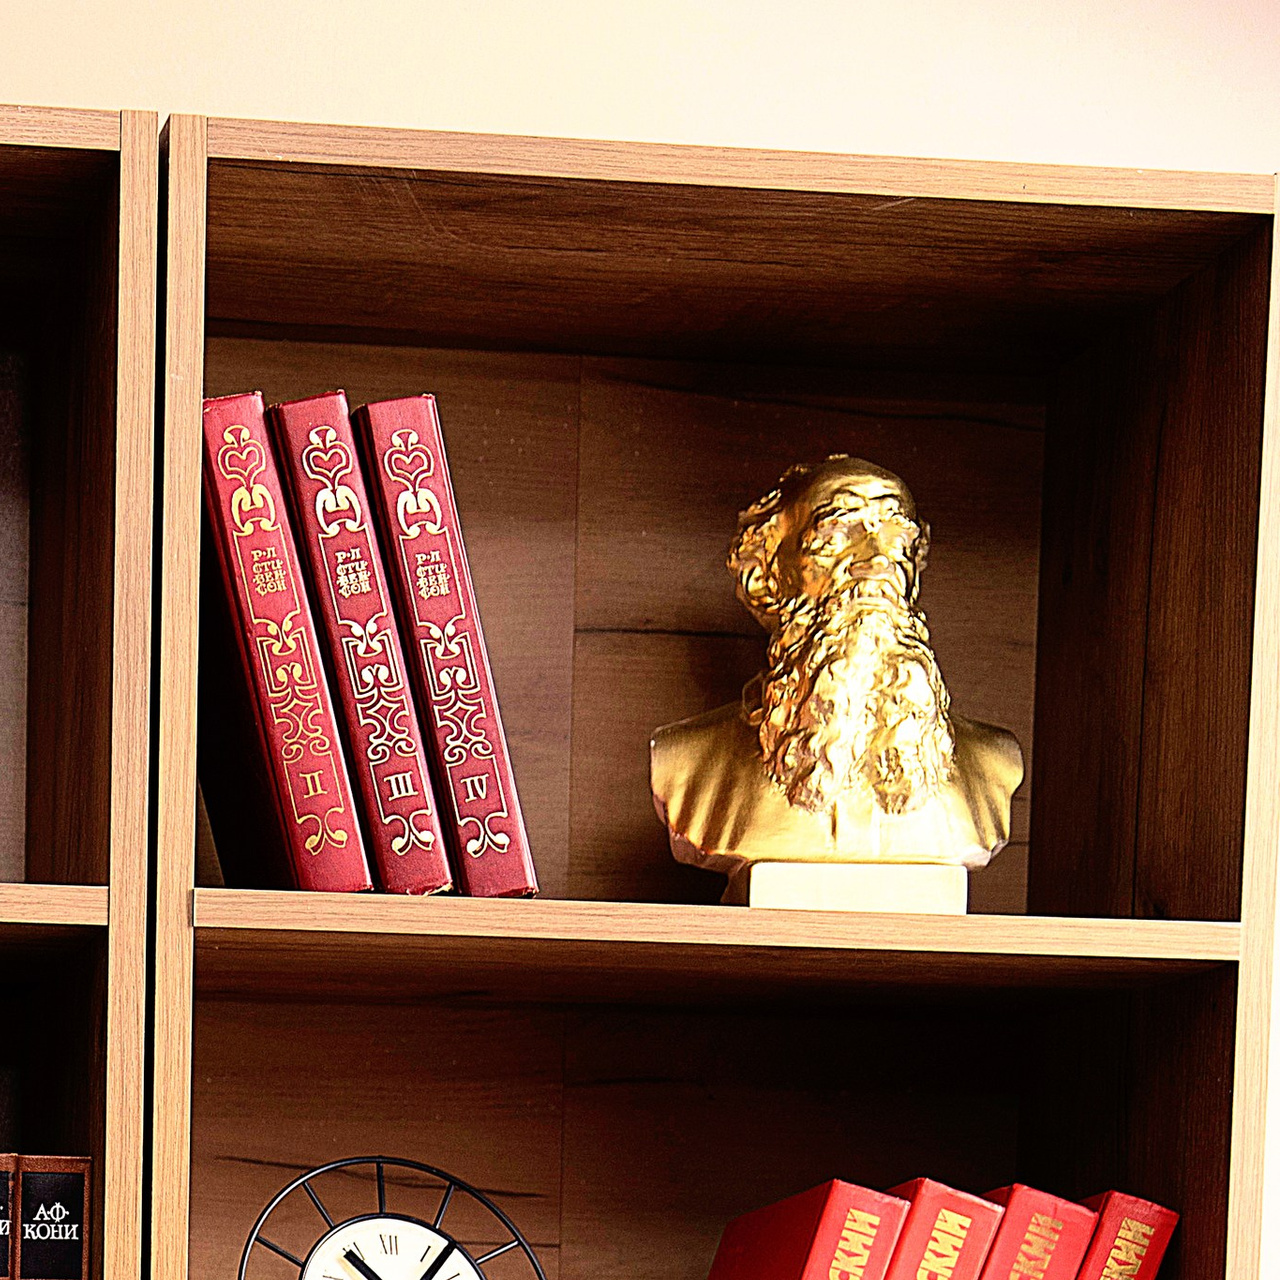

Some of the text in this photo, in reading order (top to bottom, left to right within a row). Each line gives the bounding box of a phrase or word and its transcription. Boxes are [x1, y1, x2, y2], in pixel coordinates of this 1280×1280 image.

[297, 771, 325, 797] II
[383, 770, 418, 801] III
[461, 772, 489, 801] IV
